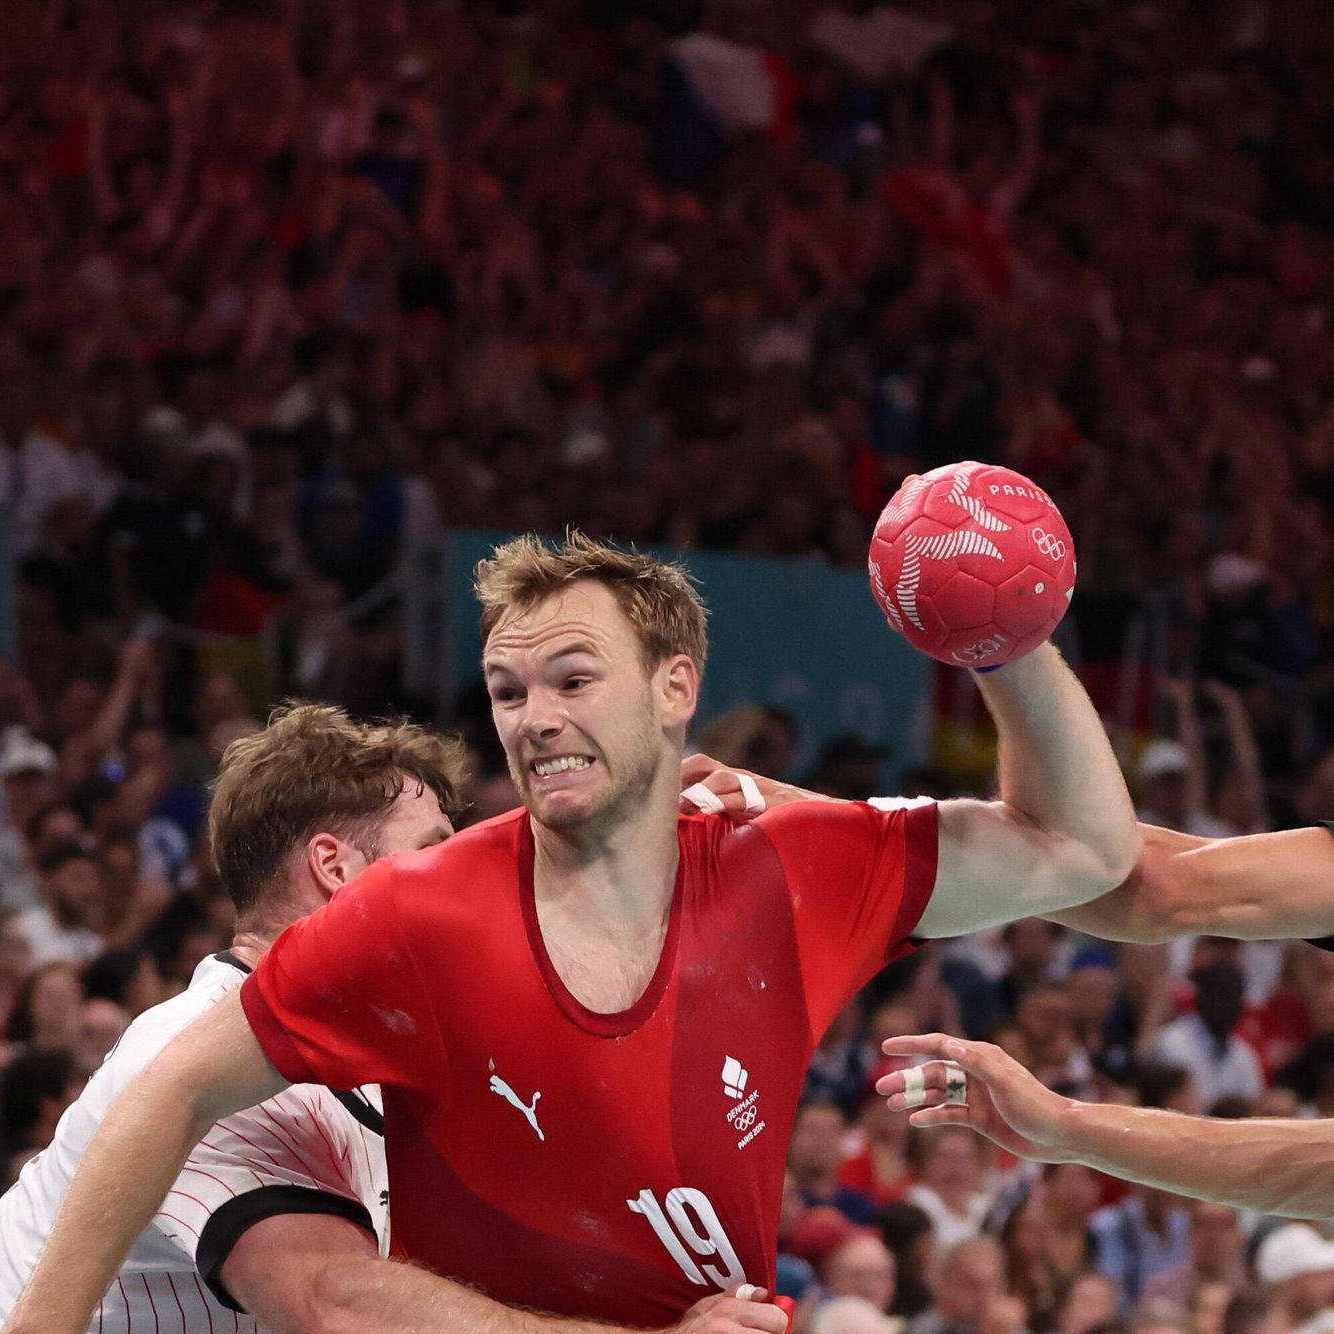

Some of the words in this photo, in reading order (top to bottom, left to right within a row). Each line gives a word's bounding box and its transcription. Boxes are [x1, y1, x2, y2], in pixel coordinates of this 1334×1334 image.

[726, 1089, 760, 1123] DENMARK
[737, 1131, 754, 1150] PARIS
[751, 1120, 766, 1137] 2024
[626, 1186, 747, 1290] 19
